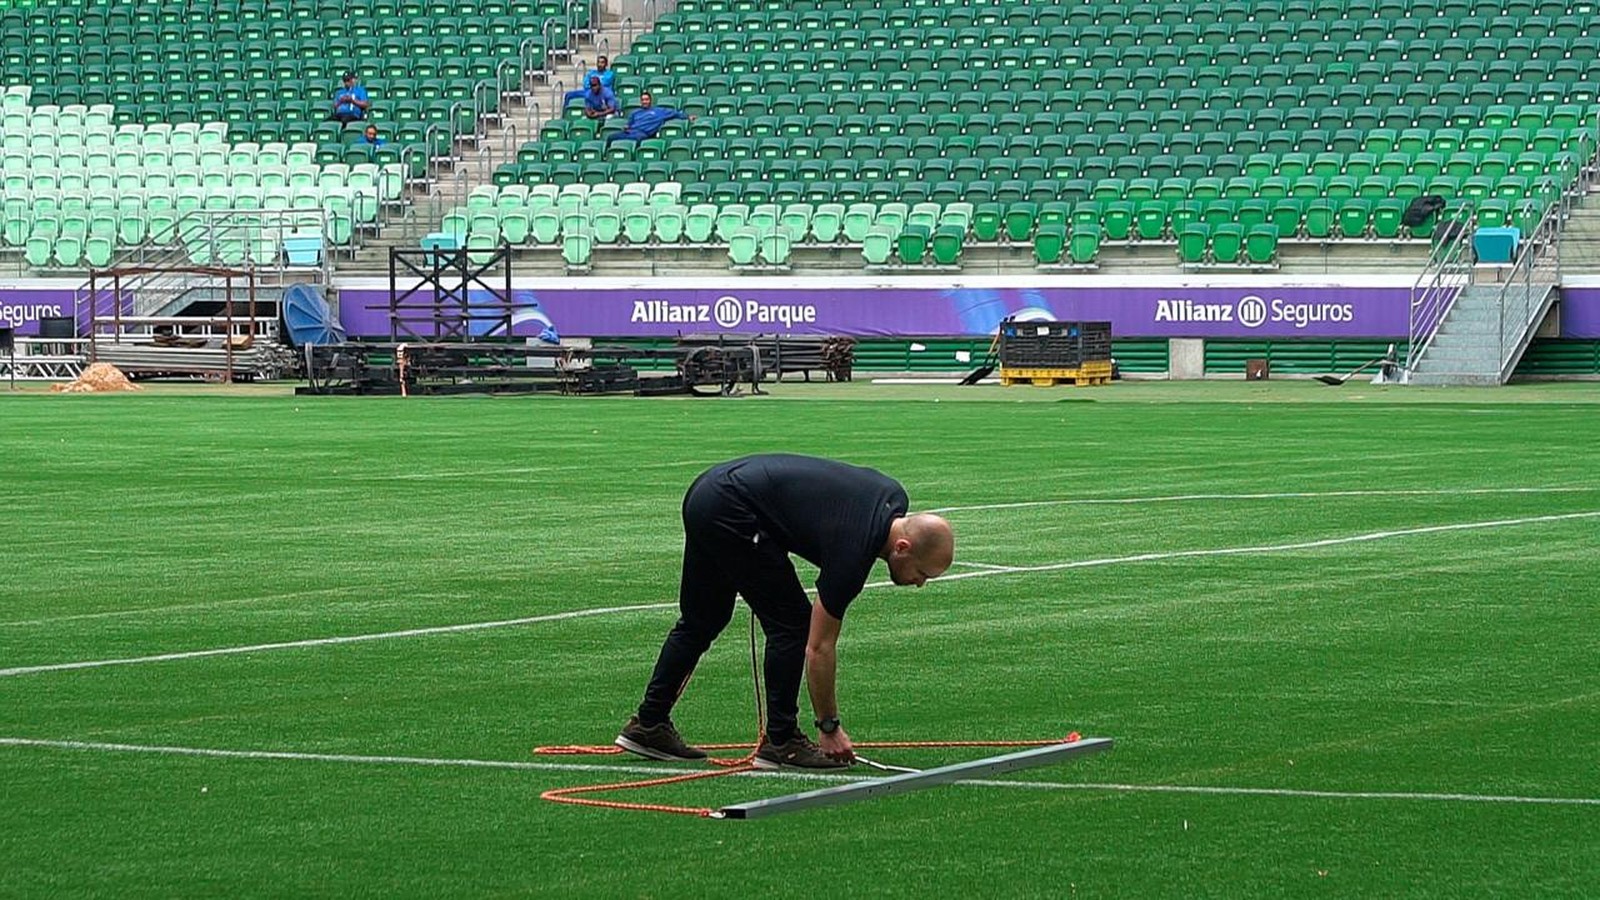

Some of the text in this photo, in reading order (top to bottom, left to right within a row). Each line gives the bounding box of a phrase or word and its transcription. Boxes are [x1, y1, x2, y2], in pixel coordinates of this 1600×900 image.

[0, 302, 62, 327] eguros
[631, 301, 816, 328] Allianz Parque
[1154, 299, 1353, 328] Allianz Seguros
